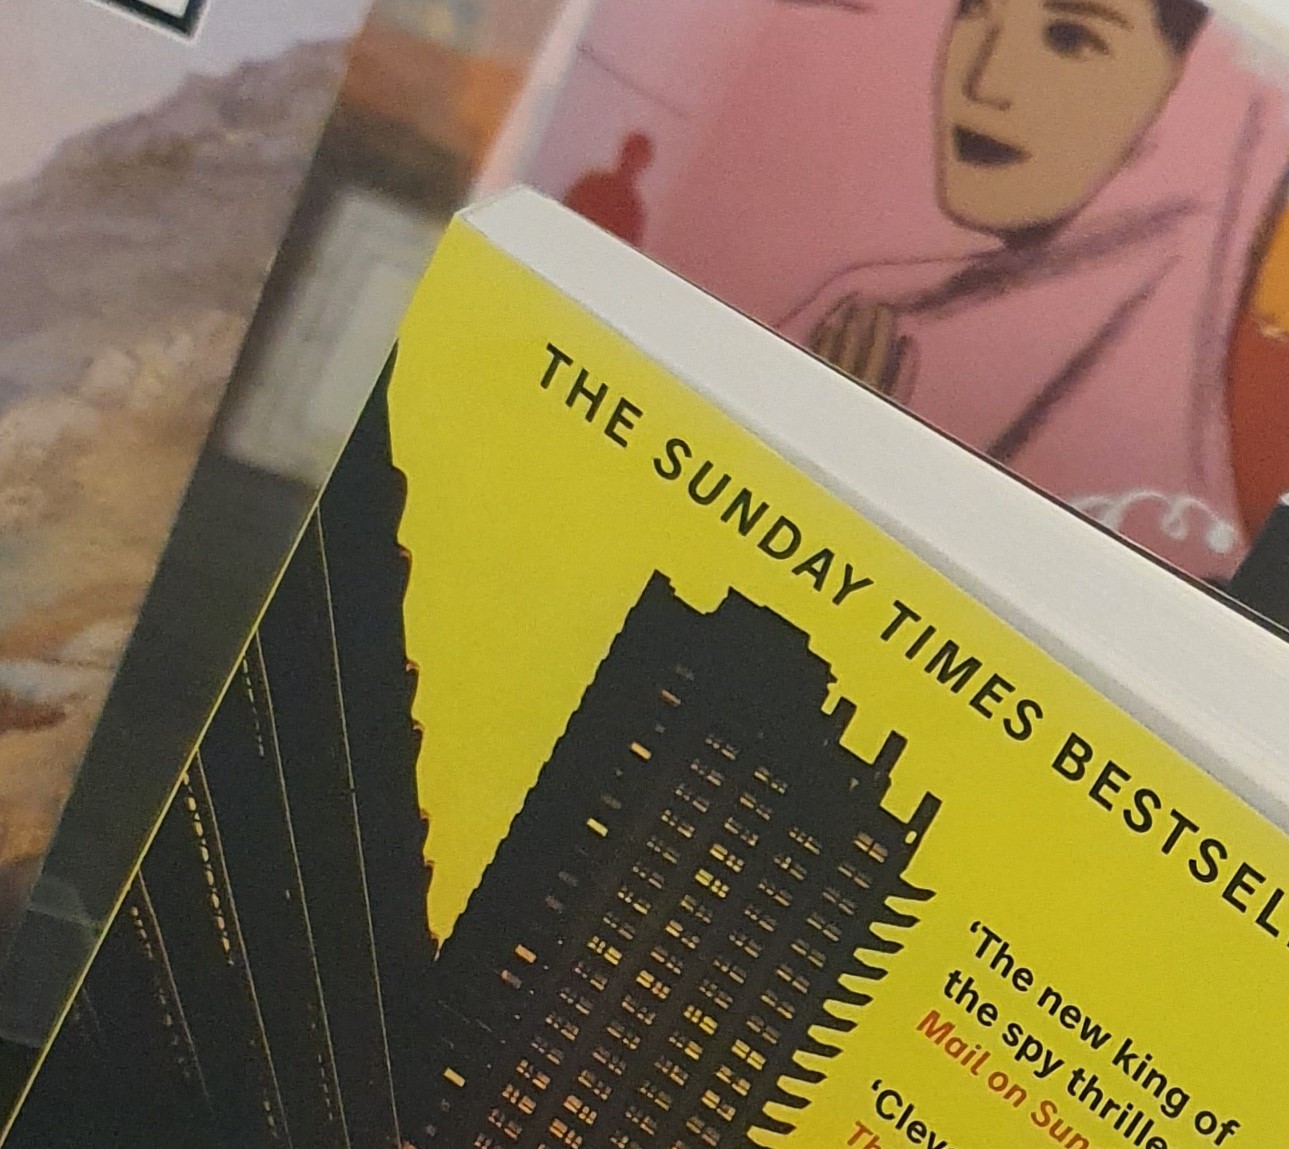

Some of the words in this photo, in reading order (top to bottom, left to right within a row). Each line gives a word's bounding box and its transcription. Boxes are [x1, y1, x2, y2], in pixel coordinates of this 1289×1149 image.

[540, 343, 644, 448] THE
[653, 438, 874, 606] SUNDAY
[880, 600, 1044, 741] TIMES
[916, 1010, 991, 1076] Mail
[987, 1070, 1028, 1108] on
[943, 970, 999, 1027] the
[1002, 1022, 1065, 1079] spy
[969, 920, 1034, 992] ‘The
[1038, 986, 1112, 1050] new
[1112, 1038, 1190, 1118] king
[1194, 1111, 1241, 1146] of
[871, 1079, 955, 1149] ‘Clev
